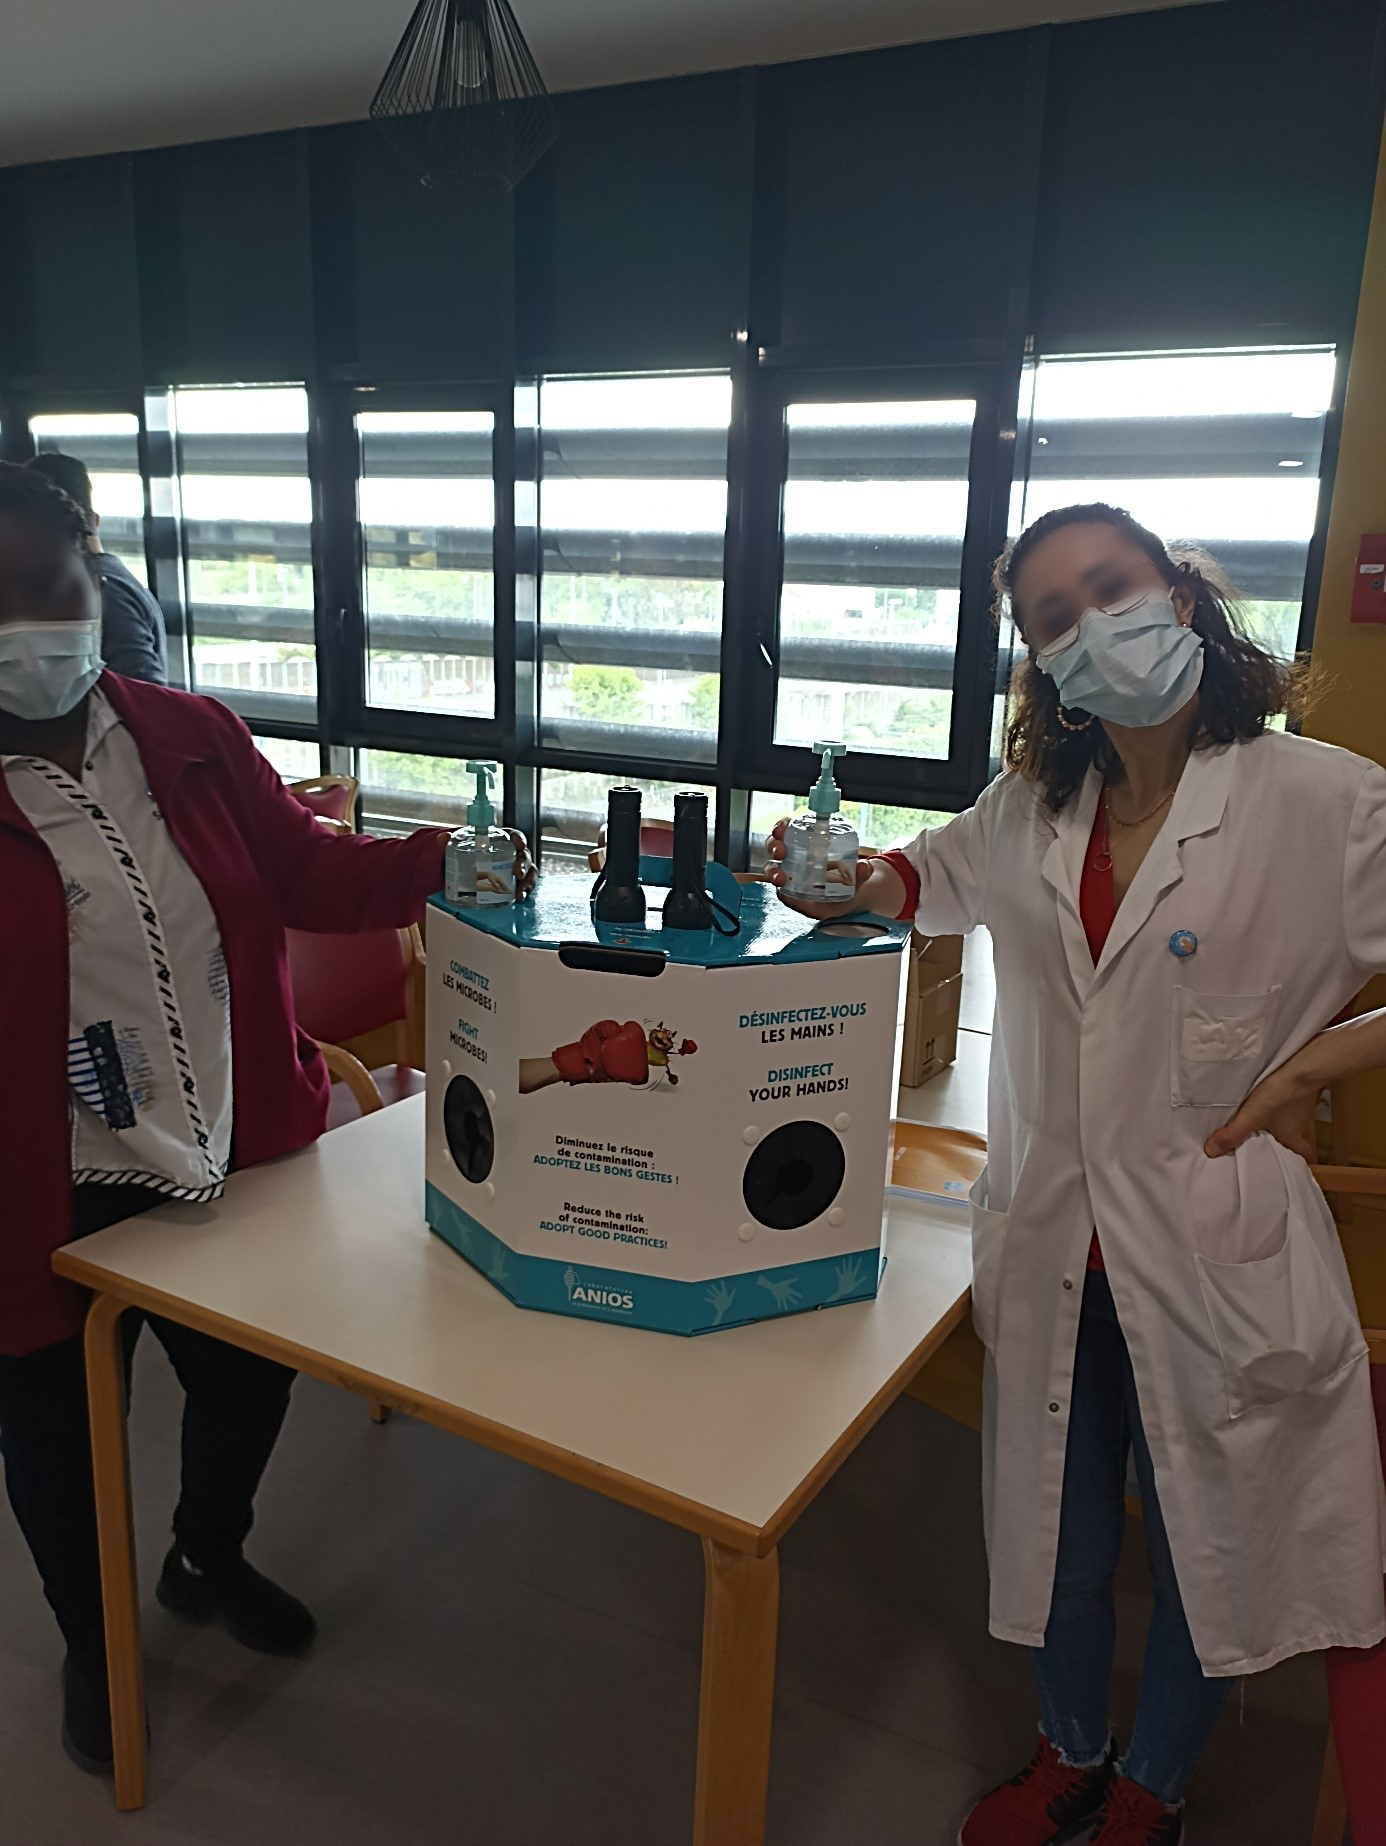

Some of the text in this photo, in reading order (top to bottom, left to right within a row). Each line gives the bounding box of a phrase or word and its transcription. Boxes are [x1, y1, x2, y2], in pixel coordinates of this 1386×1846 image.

[450, 960, 489, 991] COMBATTEZ
[443, 973, 454, 989] LES
[456, 981, 492, 1011] MICROBES
[740, 1003, 866, 1028] DÉSINFECTEZ-VOUS
[458, 1018, 479, 1040] FIGHT
[761, 1029, 785, 1043] LES
[790, 1023, 834, 1040] MAINS
[450, 1031, 488, 1063] MICROBES!
[768, 1063, 834, 1082] DISINFECT
[749, 1078, 849, 1102] YOUR HANDS!
[555, 1135, 654, 1158] Diminuez le risque
[533, 1155, 581, 1170] ADOPTEZ
[584, 1162, 600, 1173] LES
[604, 1165, 633, 1178] BONS
[636, 1170, 673, 1184] GESTES
[557, 1148, 571, 1157] de
[574, 1151, 648, 1169] contamination
[558, 1213, 649, 1235] of contamination:
[564, 1202, 644, 1223] Reduce the risk
[539, 1221, 668, 1249] ADOPT GOOD PRACTICES!
[572, 1287, 634, 1309] ANIOS
